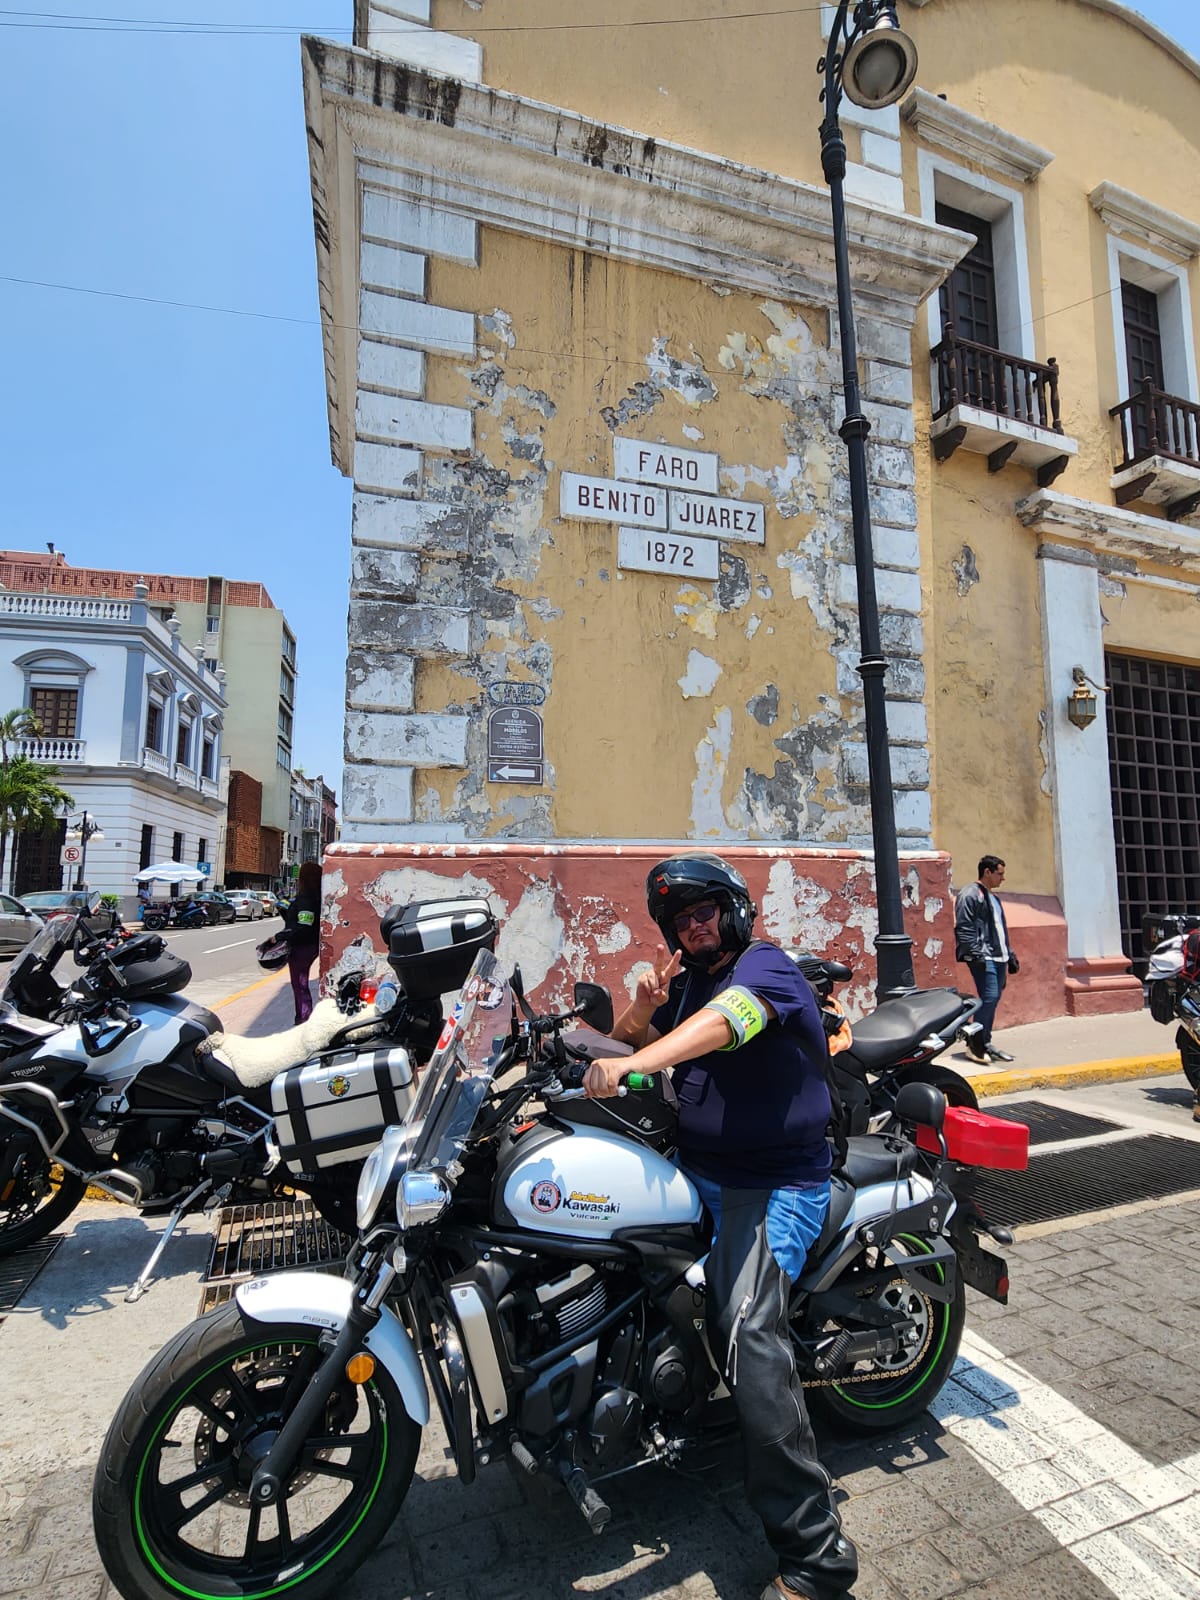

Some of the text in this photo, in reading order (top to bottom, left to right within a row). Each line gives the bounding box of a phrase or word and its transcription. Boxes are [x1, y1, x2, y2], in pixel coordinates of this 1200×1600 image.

[639, 451, 698, 481] FARO
[578, 485, 757, 533] BENITO JUAREZ
[647, 540, 694, 567] 1872
[23, 571, 180, 594] HOTEL COLOIAL
[10, 1065, 47, 1078] TRIUMPH
[88, 1129, 118, 1144] TIGER
[562, 1197, 621, 1214] Kawasaki
[570, 1212, 601, 1221] Vulcan
